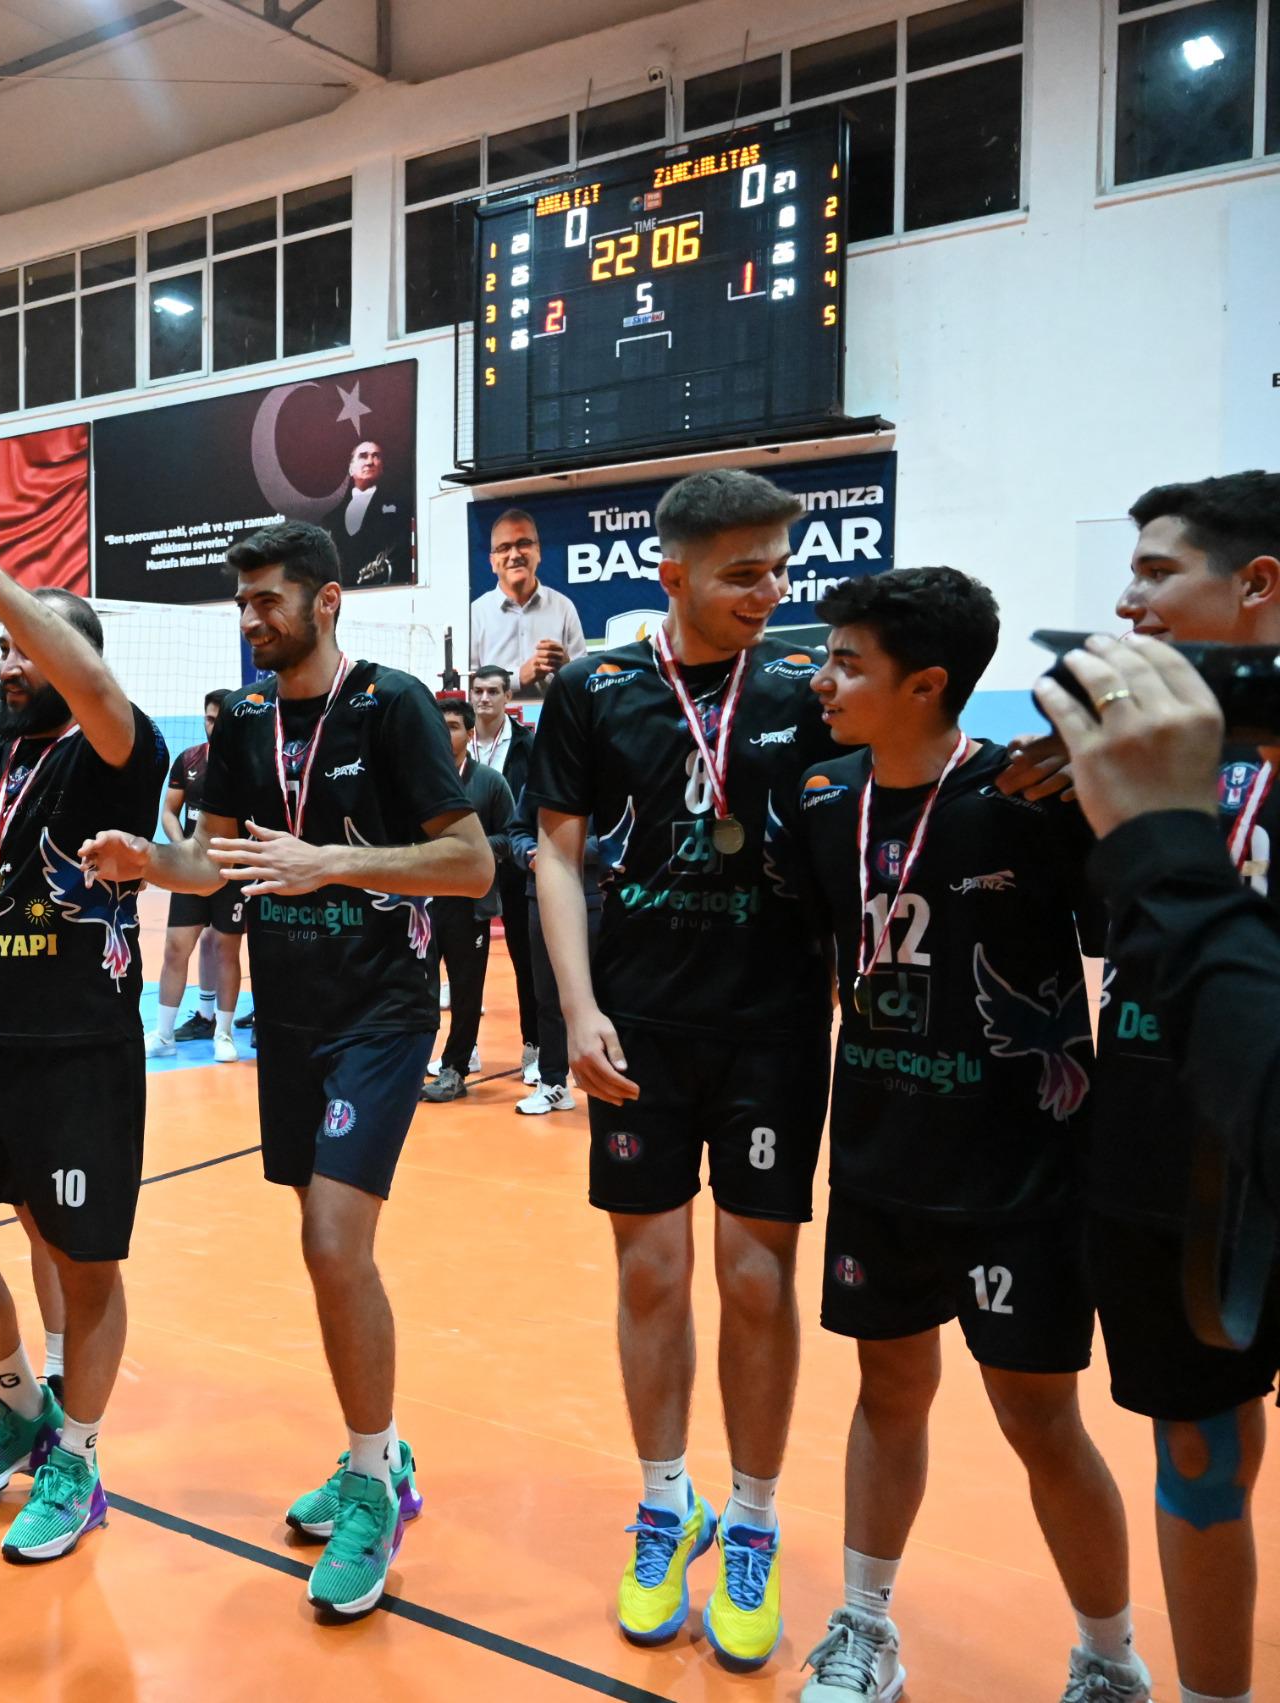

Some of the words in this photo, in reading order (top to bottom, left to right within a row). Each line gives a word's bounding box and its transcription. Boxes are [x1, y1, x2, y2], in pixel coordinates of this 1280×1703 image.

[832, 163, 840, 179] 1
[740, 163, 767, 208] 0
[825, 196, 839, 217] 2
[565, 207, 588, 248] 0
[634, 217, 658, 234] TIME
[490, 243, 497, 258] 1
[592, 235, 639, 281] 22
[652, 221, 700, 268] 06
[825, 232, 838, 253] 3
[485, 273, 496, 292] 2
[743, 261, 753, 295] 1
[824, 270, 838, 287] 4
[637, 282, 653, 314] 5
[486, 304, 496, 323] 3
[545, 300, 564, 332] 2
[824, 305, 837, 325] 5
[485, 337, 496, 353] 4
[485, 366, 496, 386] 5
[213, 522, 223, 532] ve
[245, 513, 286, 528] zamanda
[588, 508, 651, 533] Tüm
[146, 557, 178, 570] Mustafa
[180, 554, 205, 567] Kemal
[684, 748, 716, 815] 8
[231, 902, 243, 923] 3
[864, 892, 932, 967] 12
[748, 1126, 777, 1170] 8
[51, 1167, 87, 1208] 10
[968, 1264, 1014, 1314] 12
